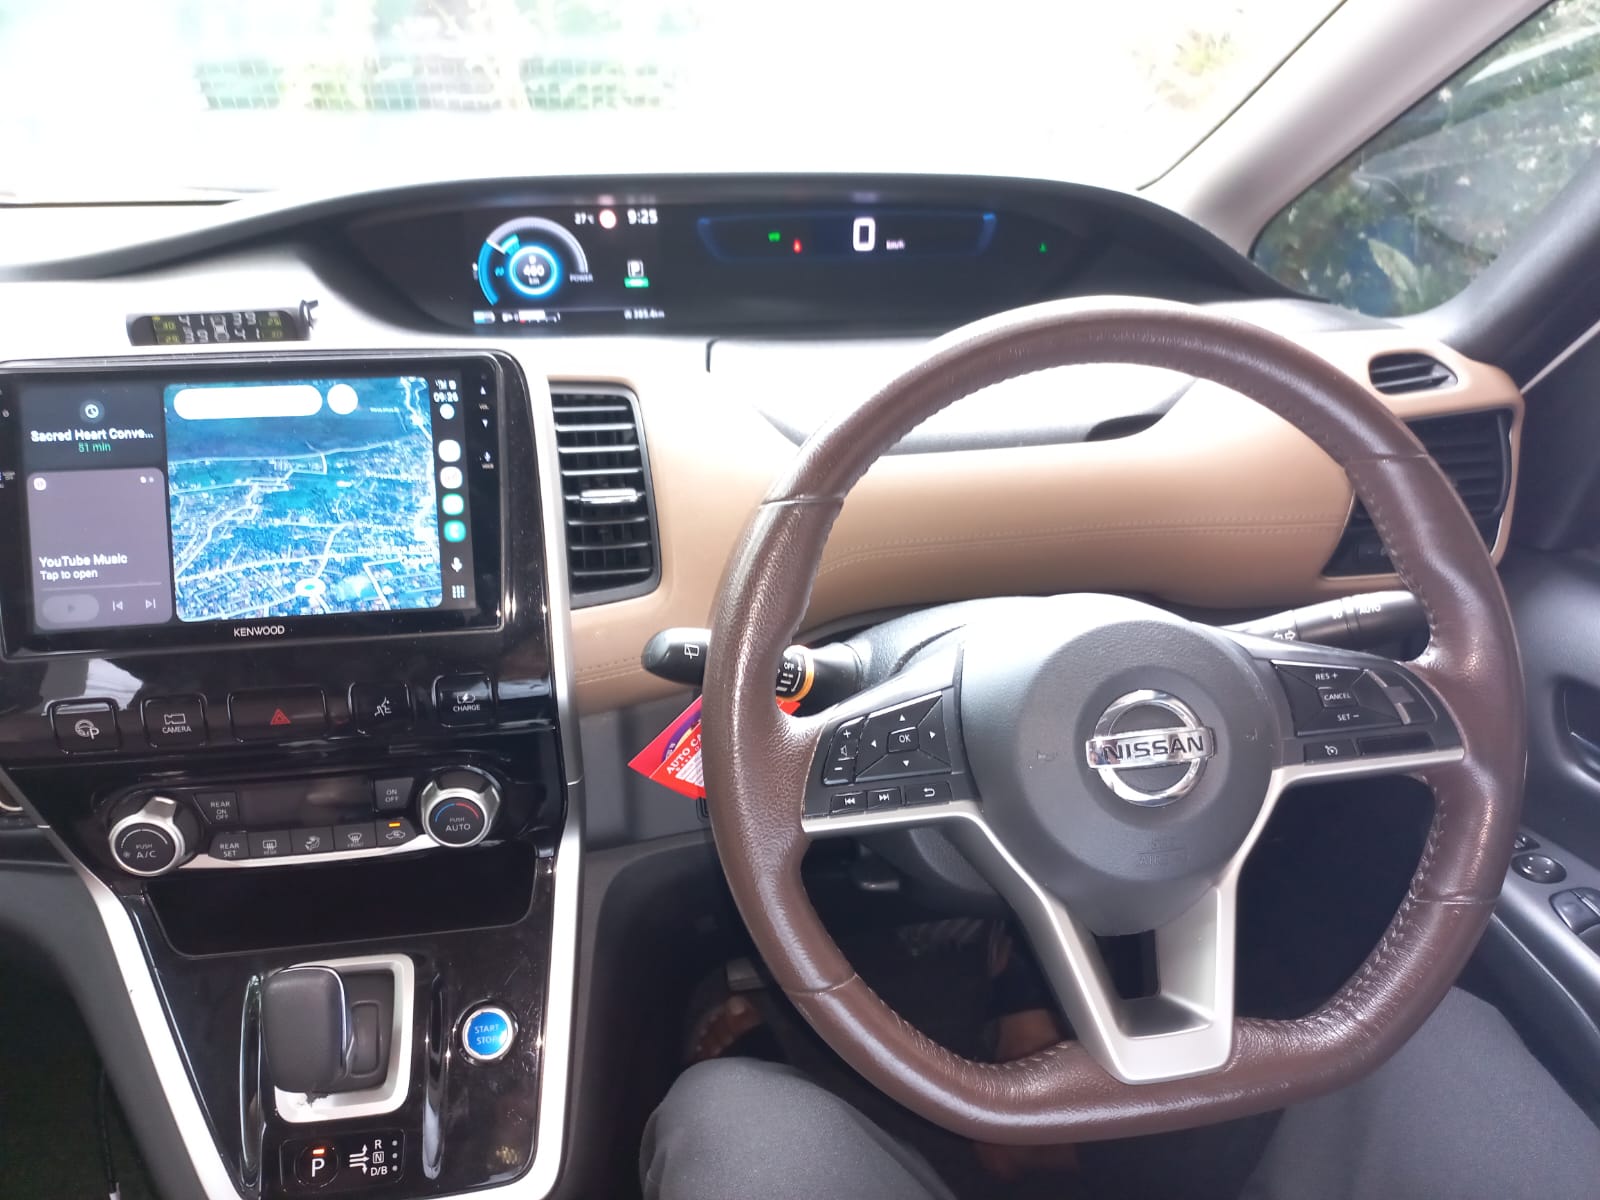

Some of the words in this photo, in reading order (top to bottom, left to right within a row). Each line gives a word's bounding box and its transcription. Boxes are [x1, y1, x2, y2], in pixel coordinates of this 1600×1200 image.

[853, 217, 876, 251] 0
[30, 429, 72, 442] Sacred
[74, 428, 108, 441] Heart
[92, 441, 112, 452] min
[39, 554, 91, 568] YouTube
[93, 553, 128, 566] Music
[40, 570, 59, 581] Tap
[61, 569, 71, 580] to
[73, 569, 98, 581] open
[233, 625, 285, 637] KENWOOD
[1315, 672, 1330, 681] RES
[1323, 692, 1351, 701] CANCEL
[453, 704, 481, 713] CHARGE
[1337, 713, 1351, 721] SET
[162, 725, 192, 734] CAMERA
[898, 734, 912, 744] OK
[1102, 735, 1205, 761] NISSAN
[666, 747, 691, 775] AUTO
[385, 795, 399, 803] OFF
[210, 801, 231, 809] REAR
[445, 823, 471, 832] AUTO
[219, 842, 240, 850] REAR
[136, 850, 157, 859] A/C
[223, 850, 237, 858] SET
[474, 1024, 500, 1034] START
[374, 1139, 383, 1150] R
[375, 1152, 383, 1162] N
[311, 1158, 325, 1178] P
[370, 1165, 388, 1177] D/B
